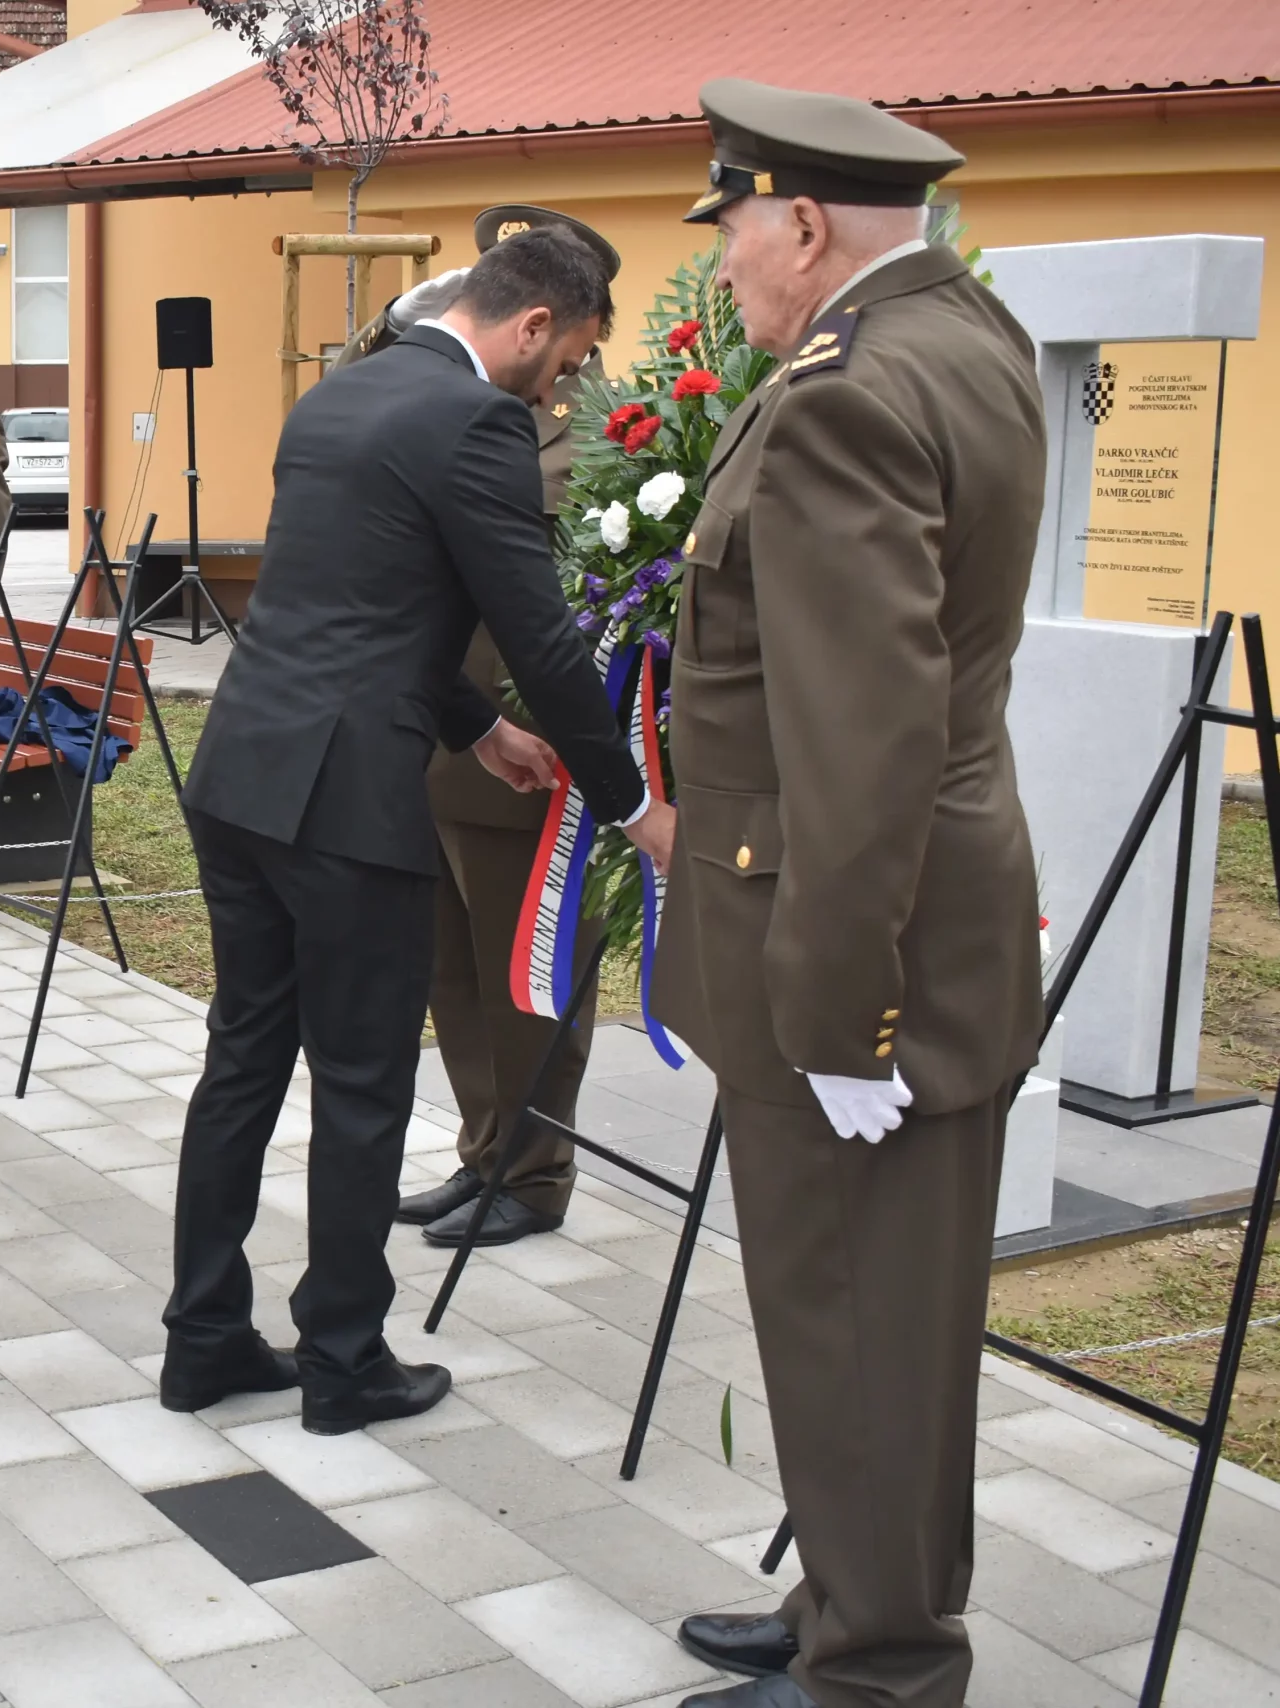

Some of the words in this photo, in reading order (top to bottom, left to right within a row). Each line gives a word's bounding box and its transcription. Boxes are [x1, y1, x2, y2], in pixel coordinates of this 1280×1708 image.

[1142, 394, 1191, 402] BRANITELJIMA
[1098, 448, 1132, 458] DARKO
[1134, 446, 1179, 458] VRANČIĆ
[1095, 468, 1143, 478] VLADIMIR
[1145, 467, 1179, 479] LEČEK
[1097, 487, 1128, 498] DAMIR
[1130, 487, 1176, 499] GOLUBIĆ
[1141, 530, 1183, 538] BRANITELJIMA
[545, 860, 568, 895] NA
